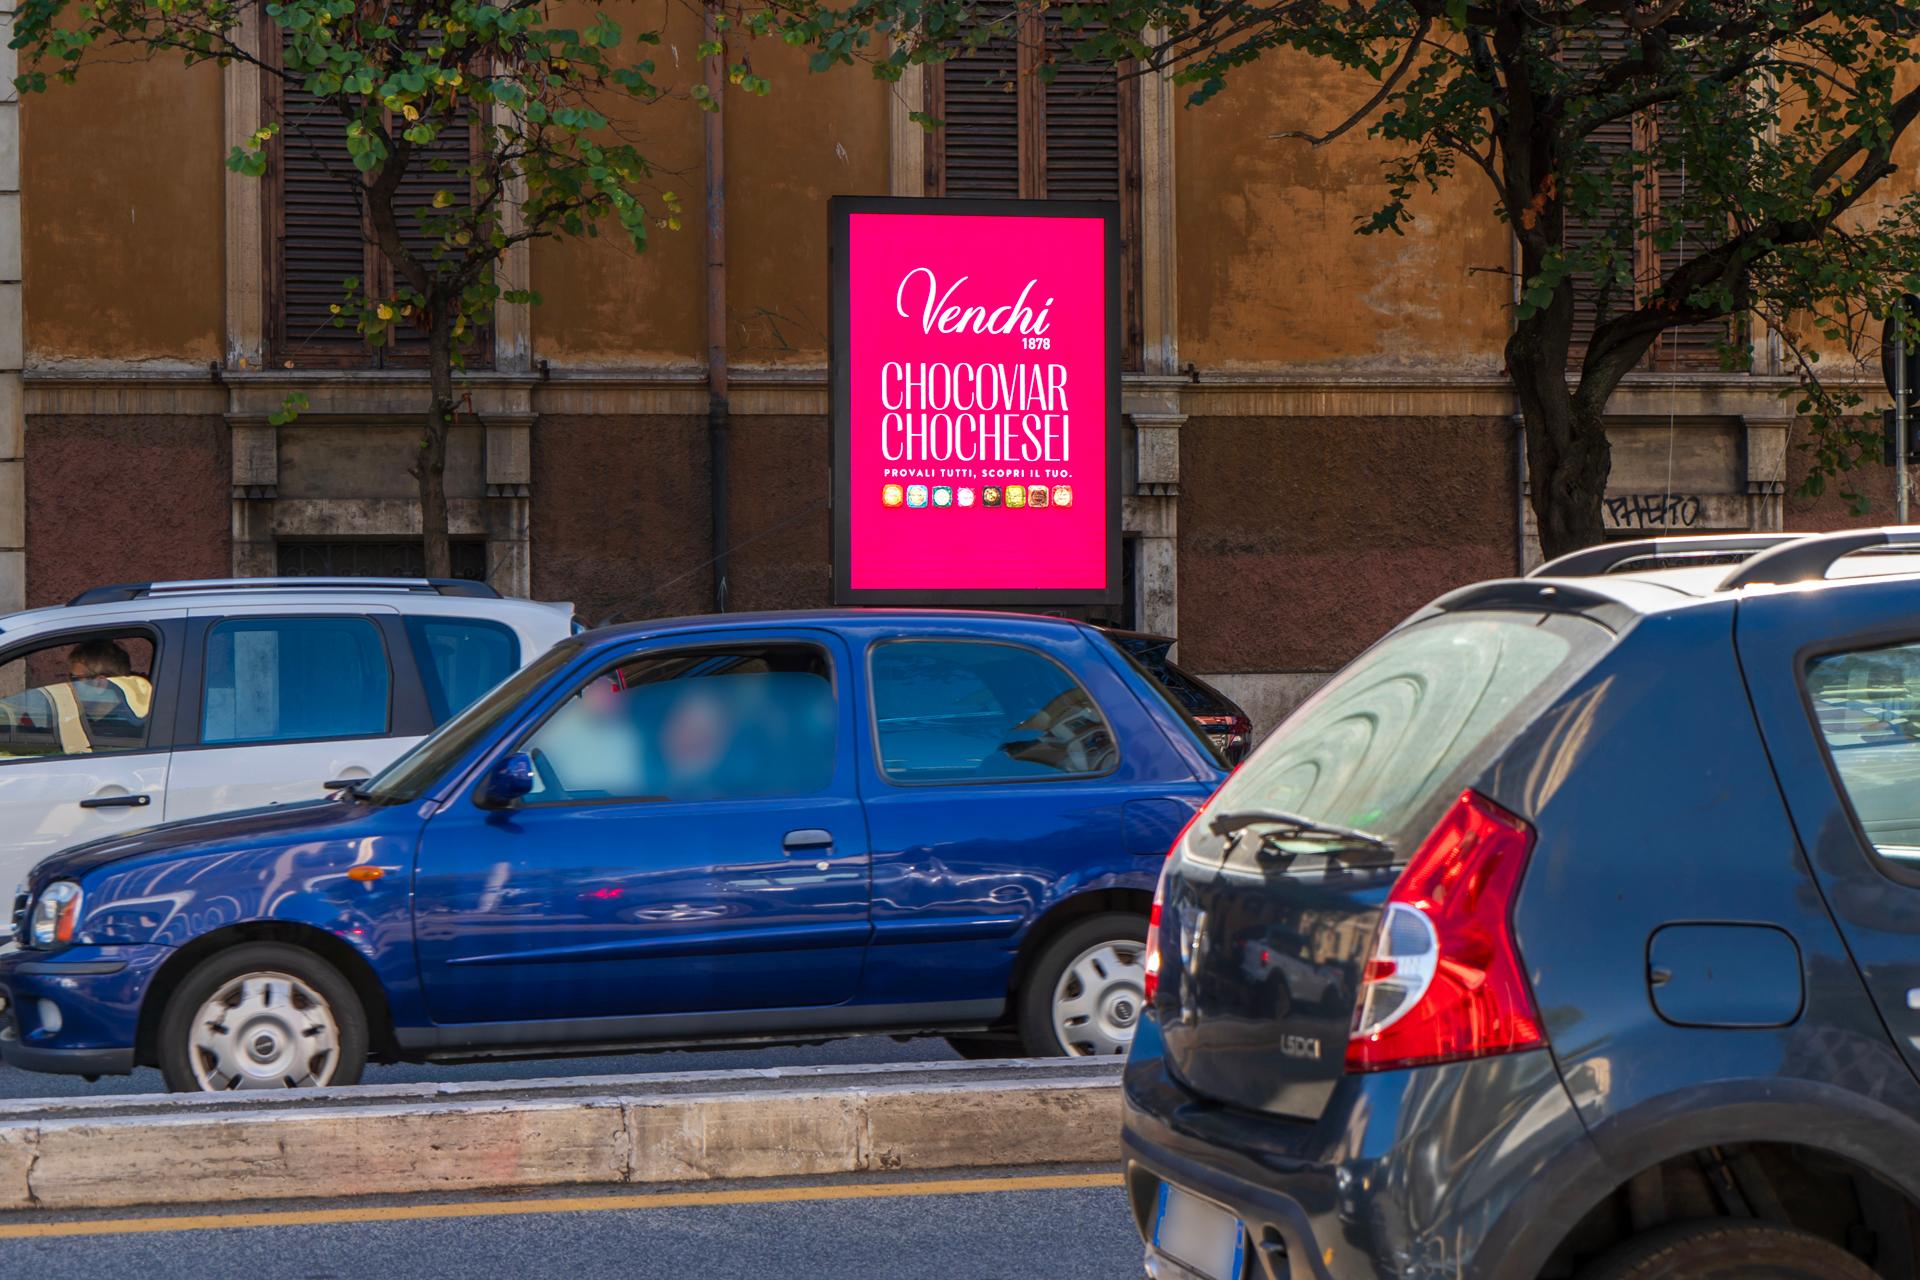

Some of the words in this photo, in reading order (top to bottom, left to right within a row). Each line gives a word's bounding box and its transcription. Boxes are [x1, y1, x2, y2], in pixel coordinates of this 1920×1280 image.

[896, 266, 1054, 335] Venchi
[1022, 337, 1051, 350] 1878
[881, 361, 1069, 411] CHOCOVIAR
[881, 412, 1070, 462] CHOCHESEI
[883, 468, 935, 478] PROVALI
[939, 468, 977, 479] TUTTI,
[981, 468, 1025, 478] SCOPRI
[1029, 468, 1041, 478] IL
[1044, 468, 1073, 478] TUO.
